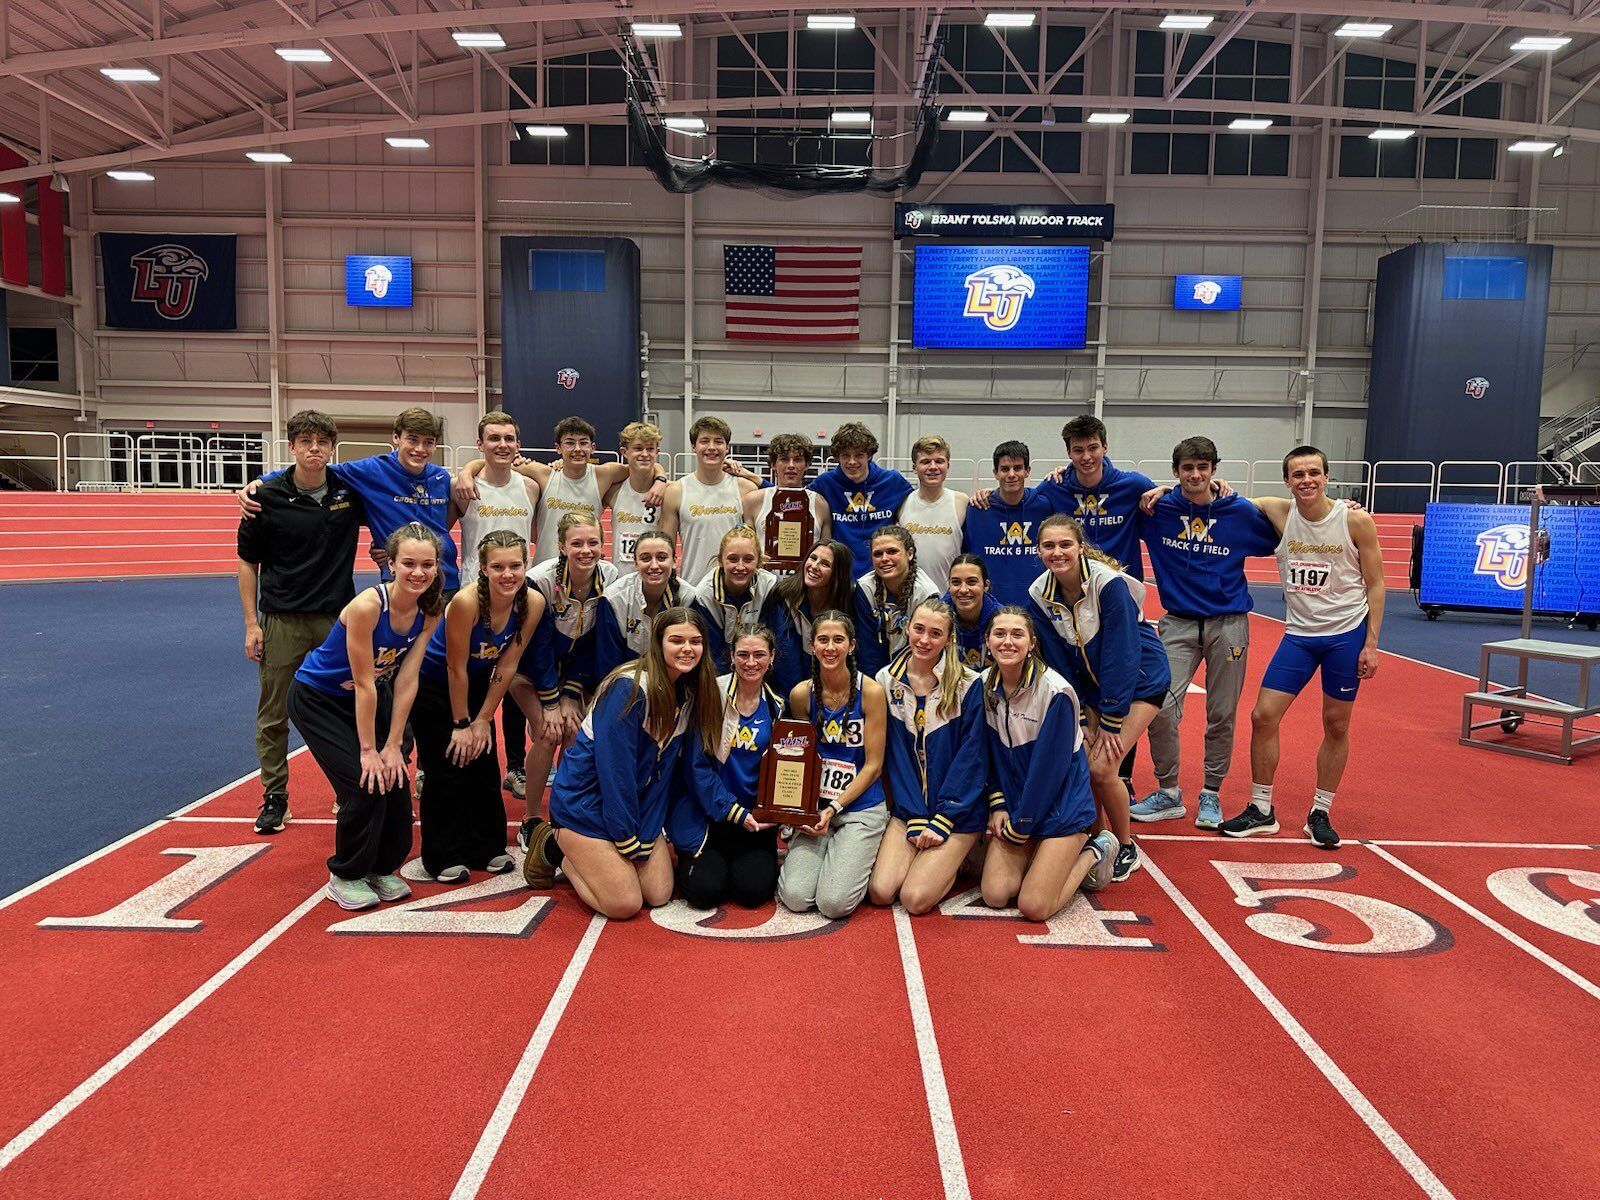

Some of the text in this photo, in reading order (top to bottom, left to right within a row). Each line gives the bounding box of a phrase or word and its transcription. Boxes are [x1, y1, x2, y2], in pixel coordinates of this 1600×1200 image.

[931, 214, 1103, 226] BRANT TOLSMA INDOOR TRACK
[477, 504, 528, 518] Warriors
[547, 497, 594, 512] Warriors
[688, 504, 738, 517] Warriors
[644, 505, 656, 523] 3
[832, 512, 859, 522] TRACK
[869, 510, 893, 521] FIELD
[1099, 515, 1124, 526] FIELD
[984, 546, 1038, 556] TRACK & FIE
[1162, 536, 1230, 556] TRACK & FIELD
[1287, 540, 1343, 554] Warriors
[1290, 568, 1329, 586] 1197
[847, 721, 862, 745] 3
[37, 842, 273, 930] 1
[1209, 859, 1438, 955] 5
